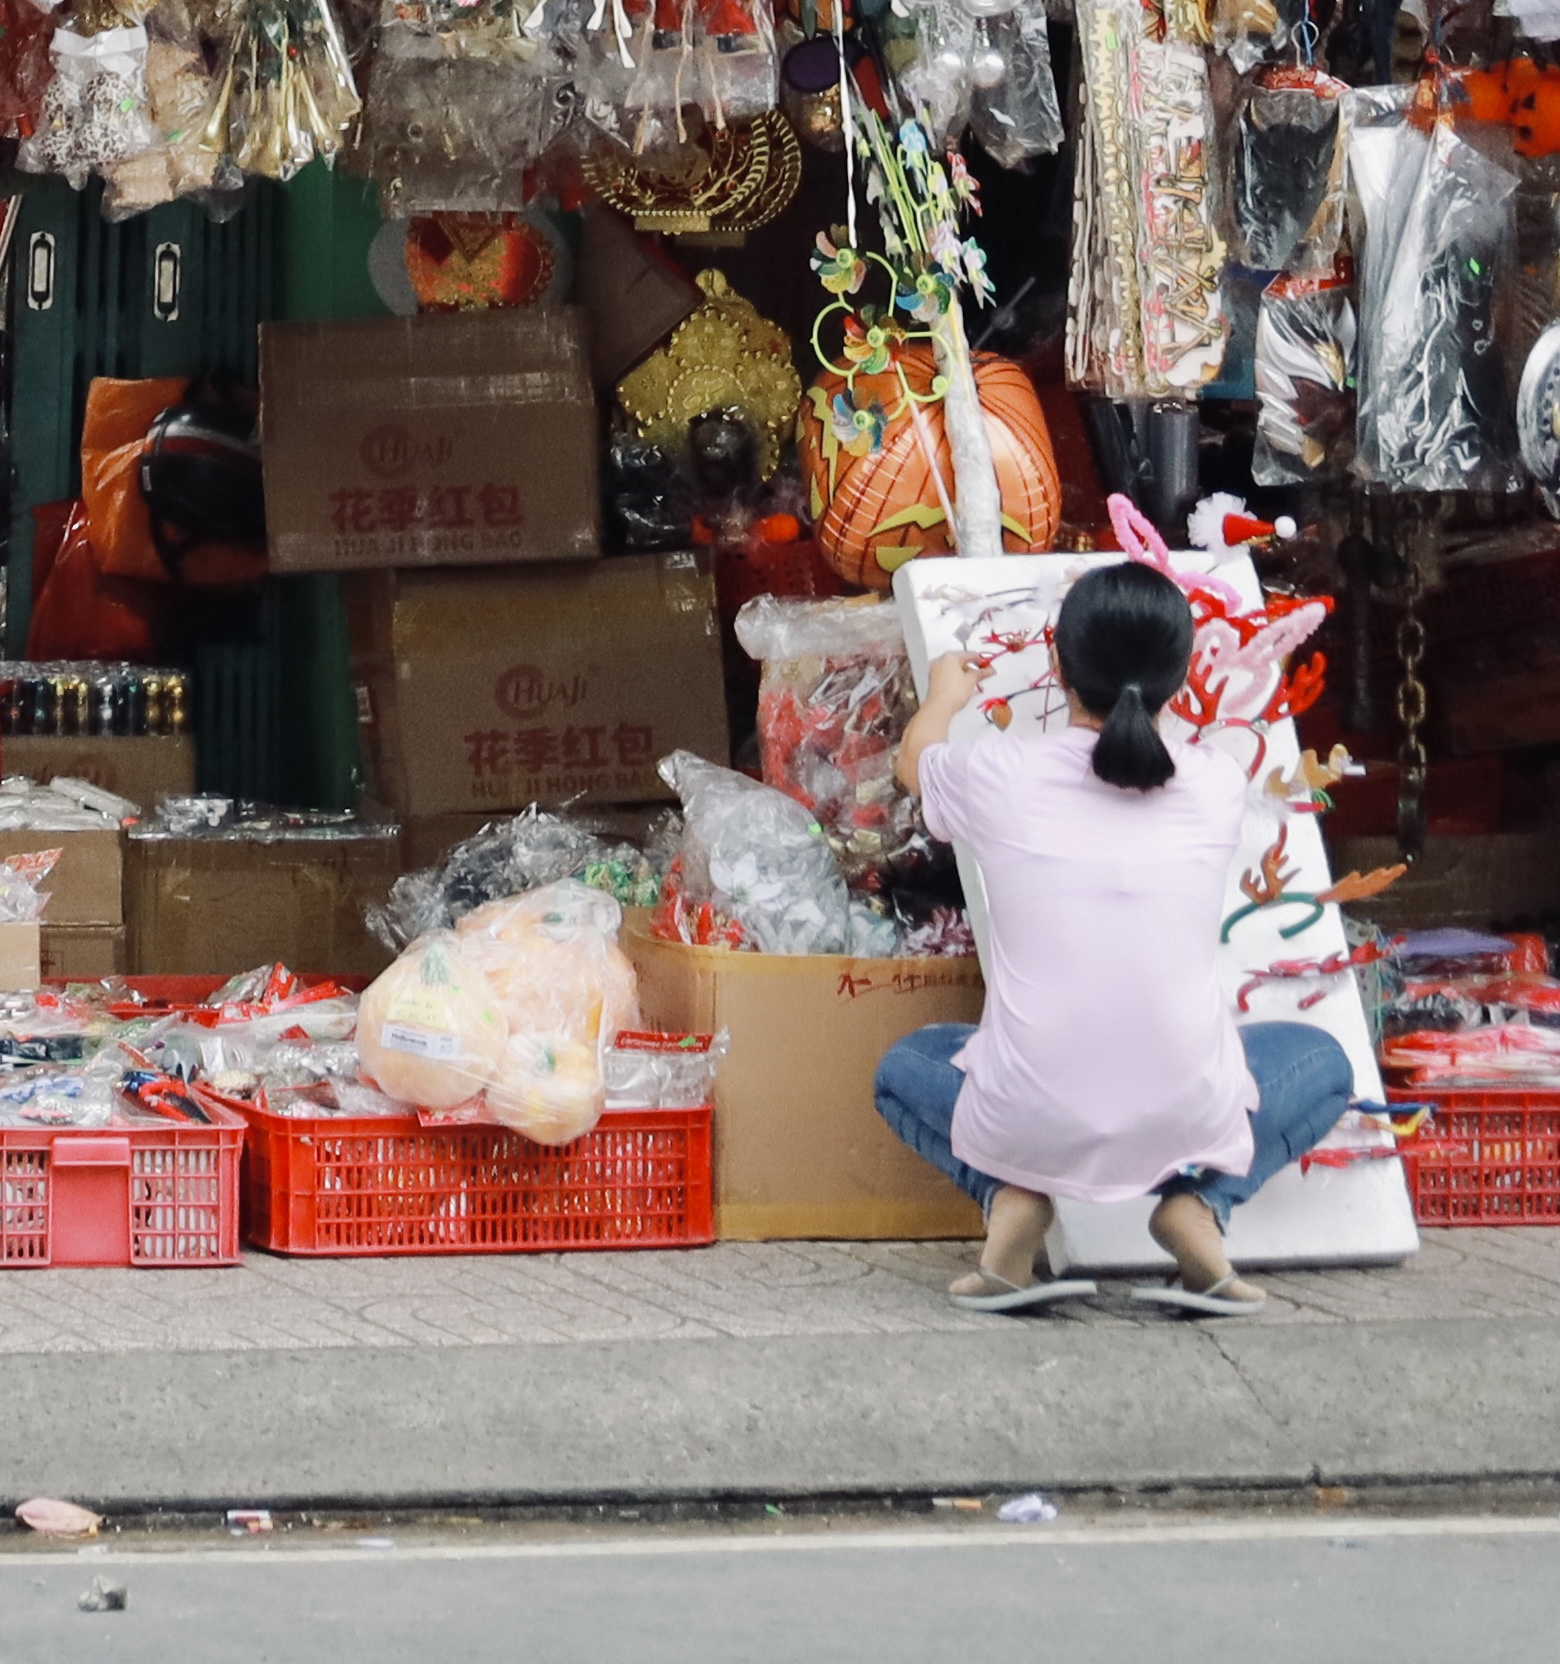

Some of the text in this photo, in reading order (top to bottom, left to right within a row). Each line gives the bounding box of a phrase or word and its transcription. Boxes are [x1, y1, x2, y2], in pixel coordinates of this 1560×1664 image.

[328, 482, 526, 535] 花季红包
[464, 719, 656, 777] 花季红包
